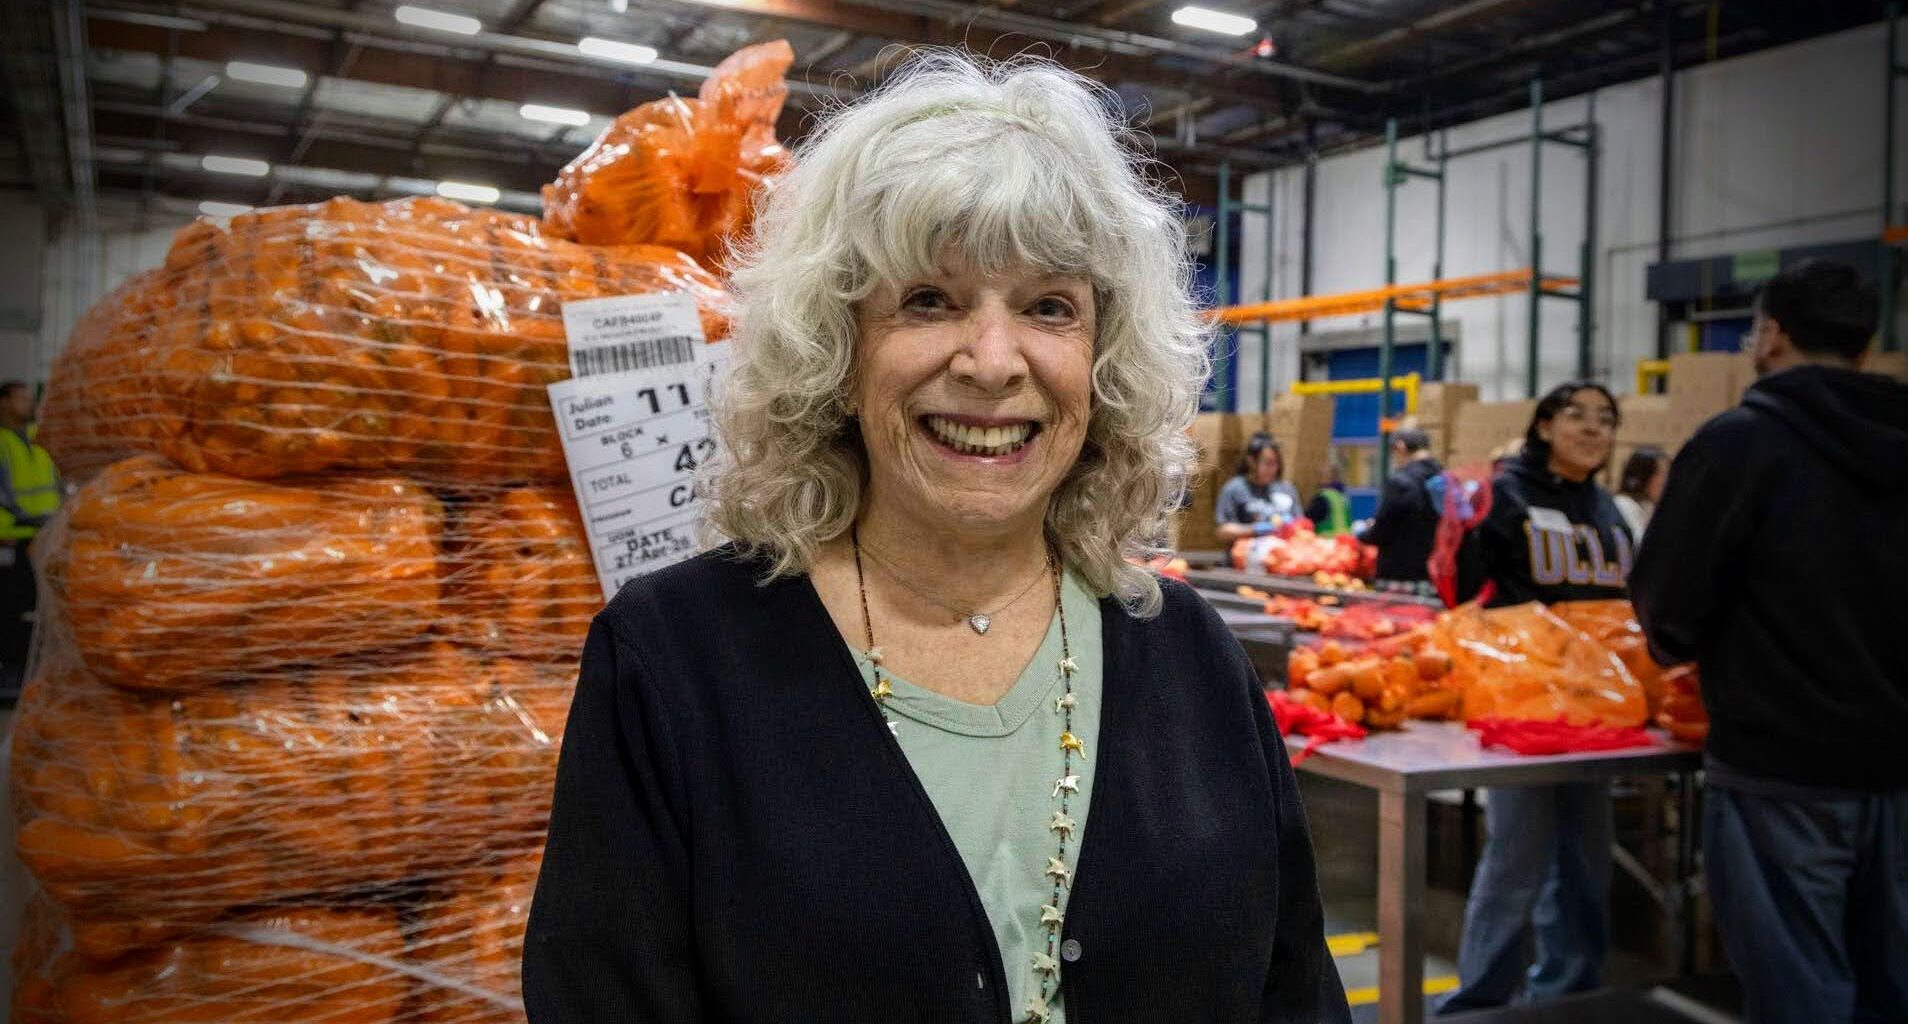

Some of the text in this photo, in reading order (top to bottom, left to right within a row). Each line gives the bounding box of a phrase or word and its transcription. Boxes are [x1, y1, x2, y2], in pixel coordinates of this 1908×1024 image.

[569, 395, 614, 415] Julian
[601, 427, 644, 446] BLOCK
[620, 442, 634, 458] 6
[591, 473, 632, 492] TOTAL
[627, 527, 673, 551] DATE
